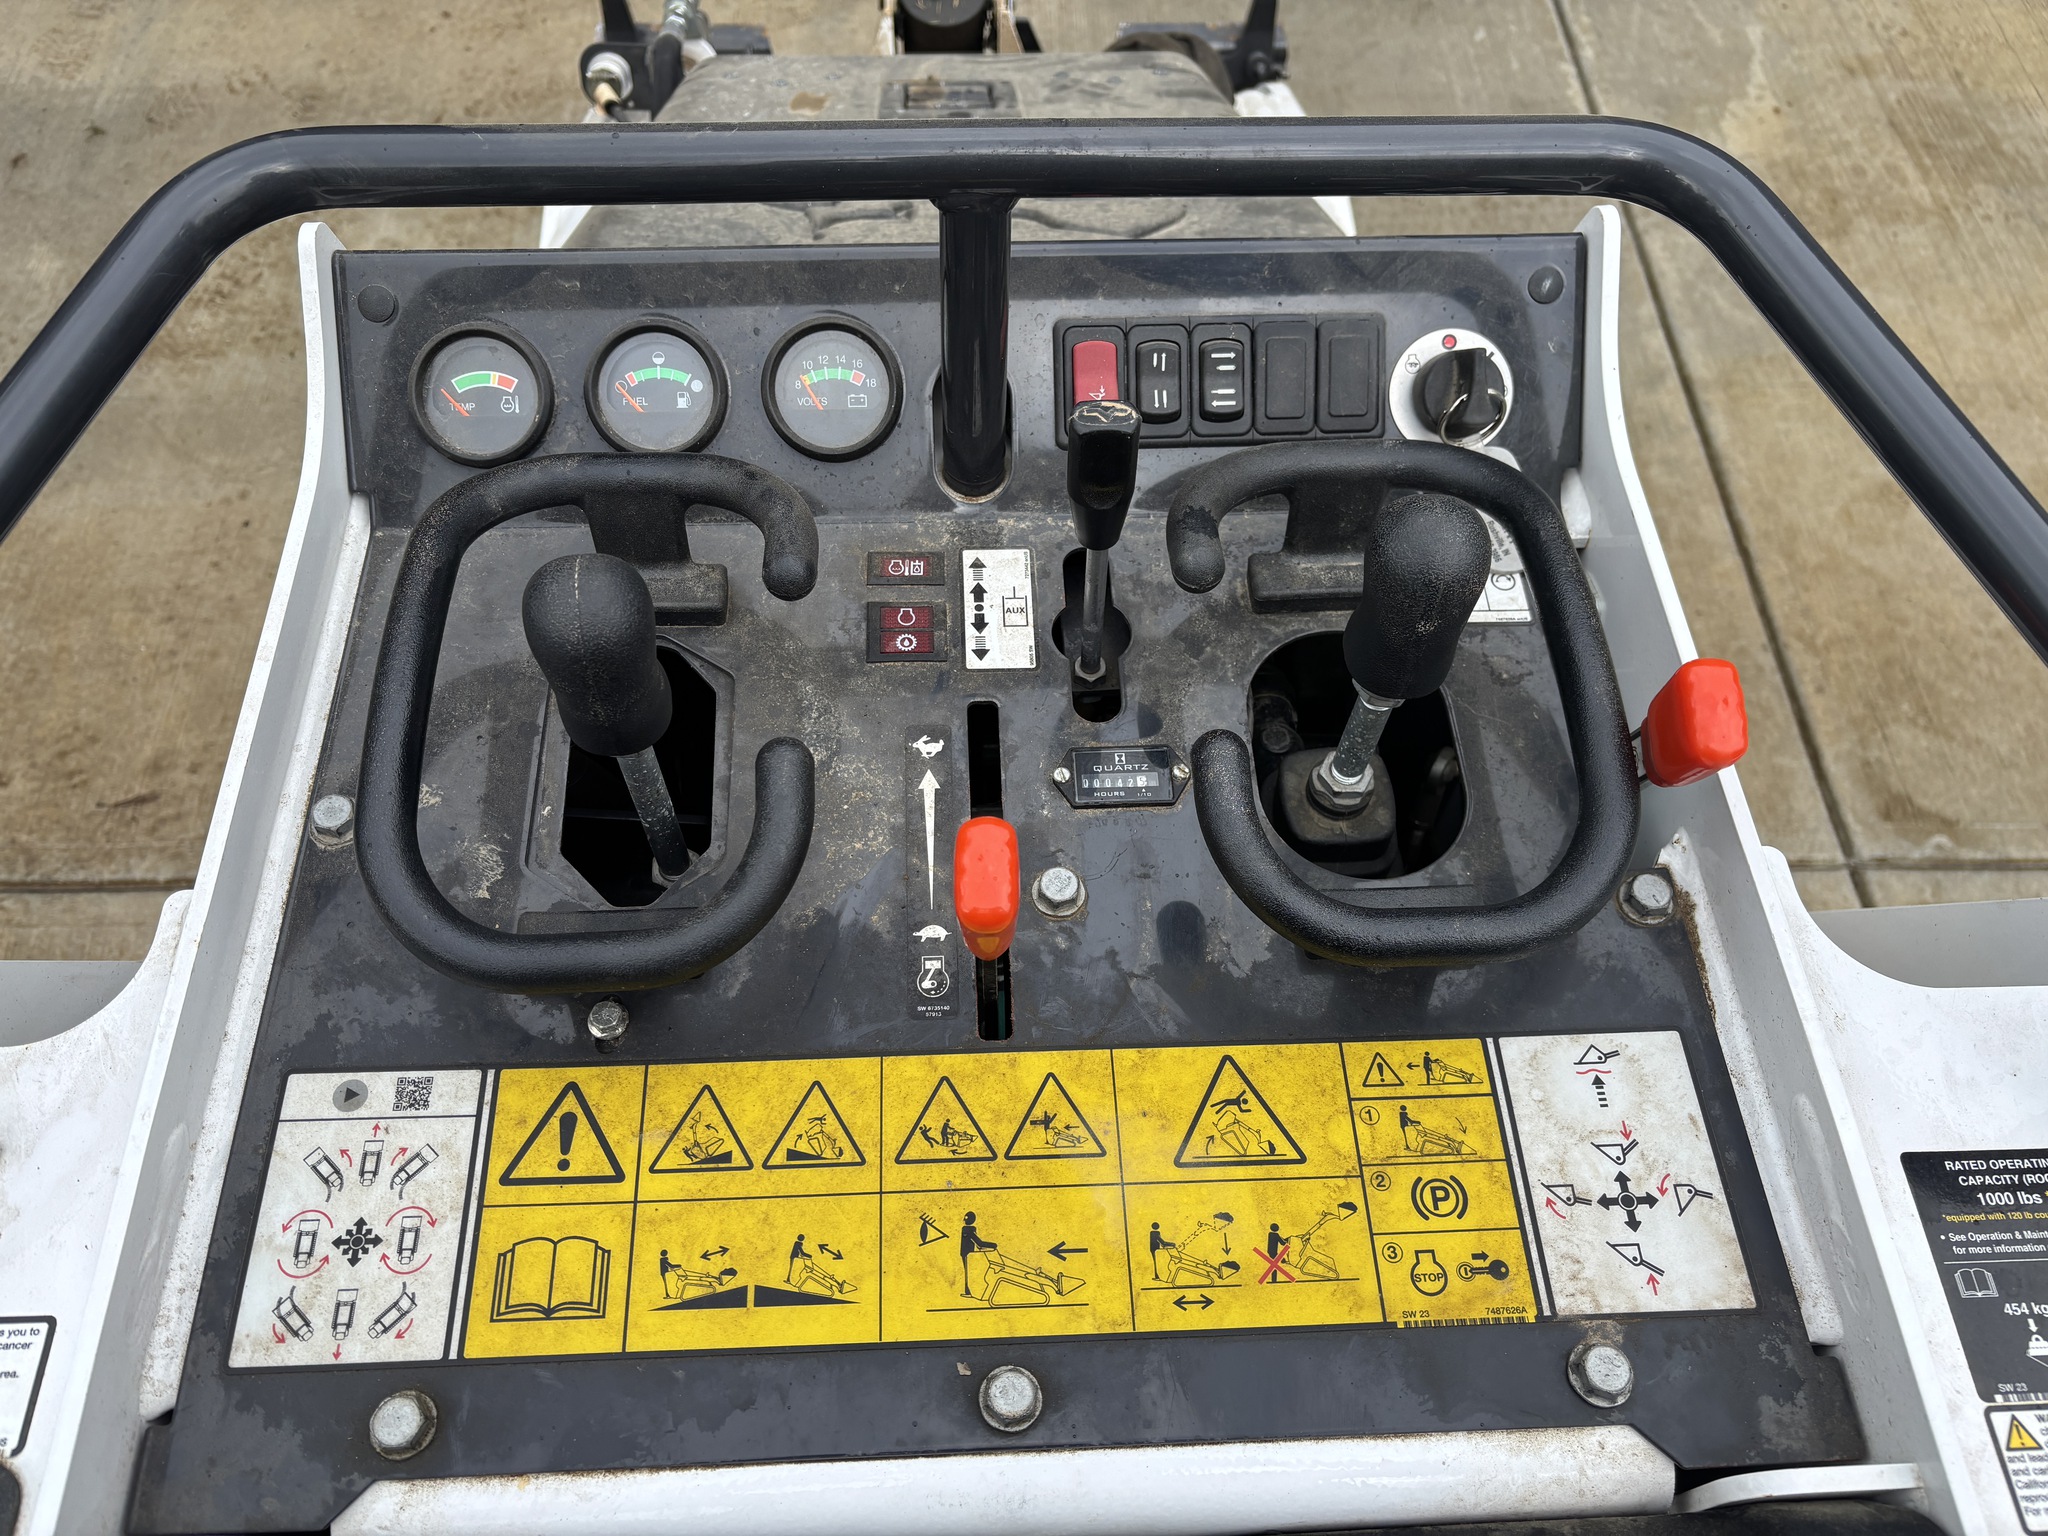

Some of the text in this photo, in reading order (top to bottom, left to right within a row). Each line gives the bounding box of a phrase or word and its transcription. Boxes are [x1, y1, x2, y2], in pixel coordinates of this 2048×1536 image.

[818, 355, 829, 364] 12
[835, 355, 846, 364] 14
[852, 359, 863, 368] 16
[802, 361, 813, 369] 10
[795, 380, 802, 389] 8
[866, 379, 877, 388] 18
[449, 402, 475, 411] TMP
[1093, 764, 1149, 773] QUARTZ
[1944, 1160, 1987, 1171] RATED
[1958, 1174, 2019, 1186] CAPACITY
[1430, 1186, 1451, 1211] P
[1977, 1191, 2043, 1206] 1000 lbs
[1987, 1212, 2006, 1221] with
[2007, 1212, 2023, 1220] 120
[2024, 1211, 2033, 1219] lb
[1948, 1232, 1967, 1242] See
[1967, 1231, 2013, 1243] Operation
[2014, 1230, 2023, 1239] &
[1952, 1243, 2046, 1255] for more information
[1414, 1273, 1444, 1283] STOP
[1402, 1310, 1430, 1318] SW 23
[1485, 1306, 1528, 1315] 7487626A
[2004, 1302, 2048, 1317] 454 kg
[7, 1329, 27, 1339] you
[30, 1327, 40, 1336] to
[1997, 1382, 2028, 1393] SW 23
